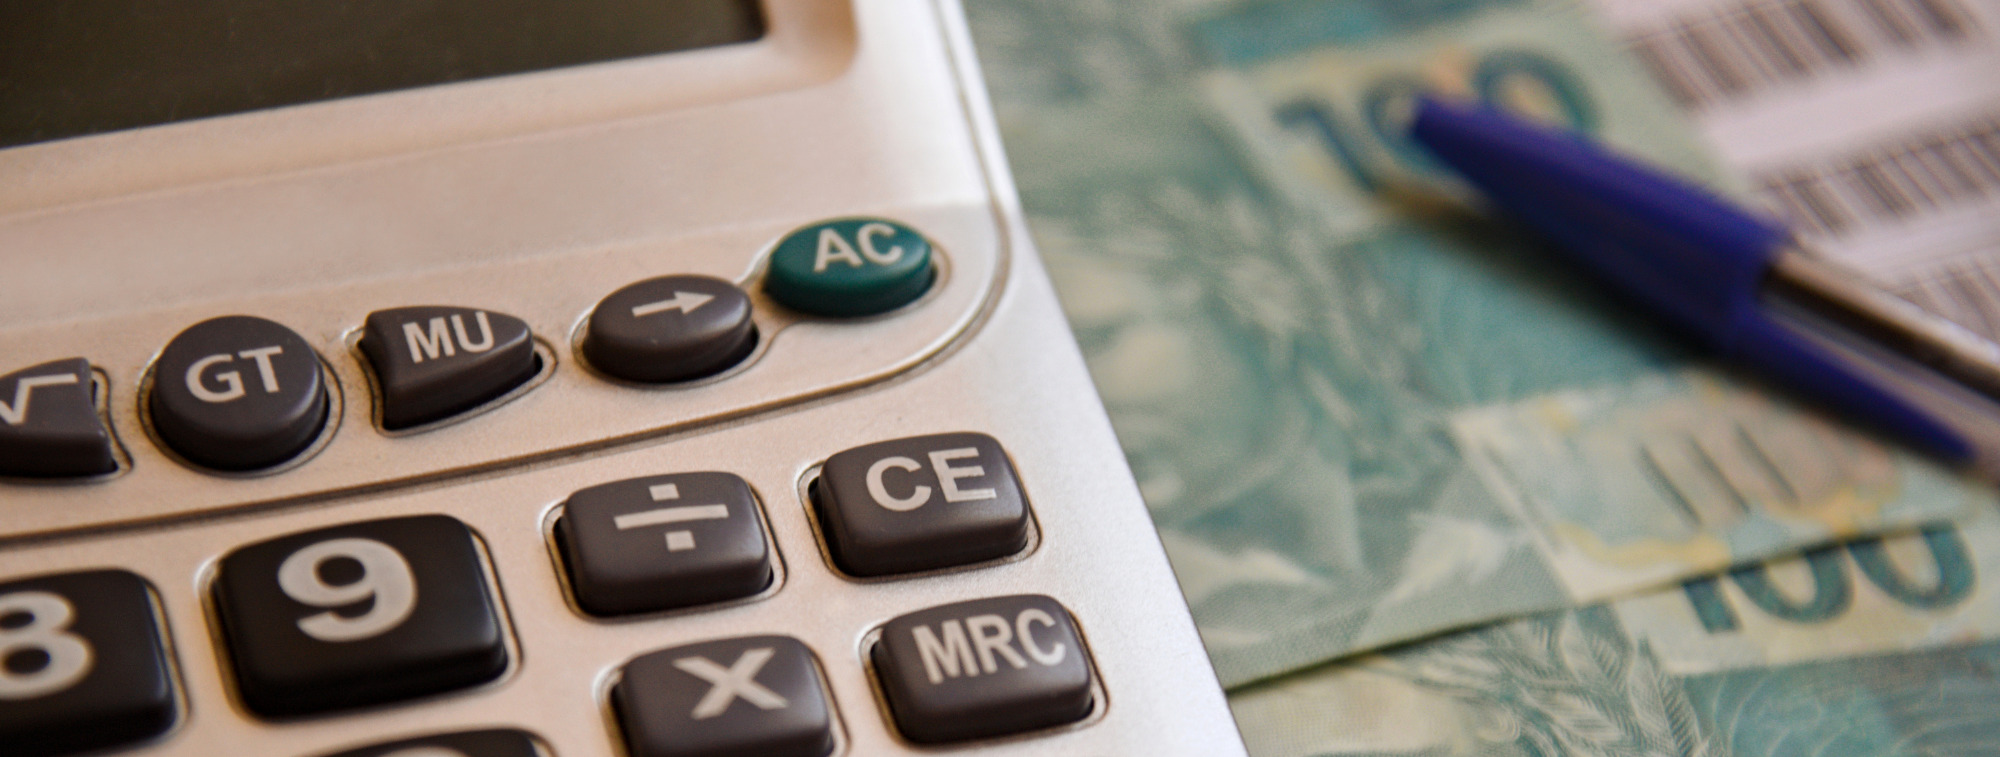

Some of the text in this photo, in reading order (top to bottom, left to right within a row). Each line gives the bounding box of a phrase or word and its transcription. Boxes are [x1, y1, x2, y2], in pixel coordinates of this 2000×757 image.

[814, 223, 903, 271] AC
[402, 312, 494, 363] MU
[185, 346, 284, 402] GT
[866, 447, 997, 511] CE
[277, 537, 418, 642] 9
[0, 591, 93, 699] 8
[912, 608, 1067, 684] MRC
